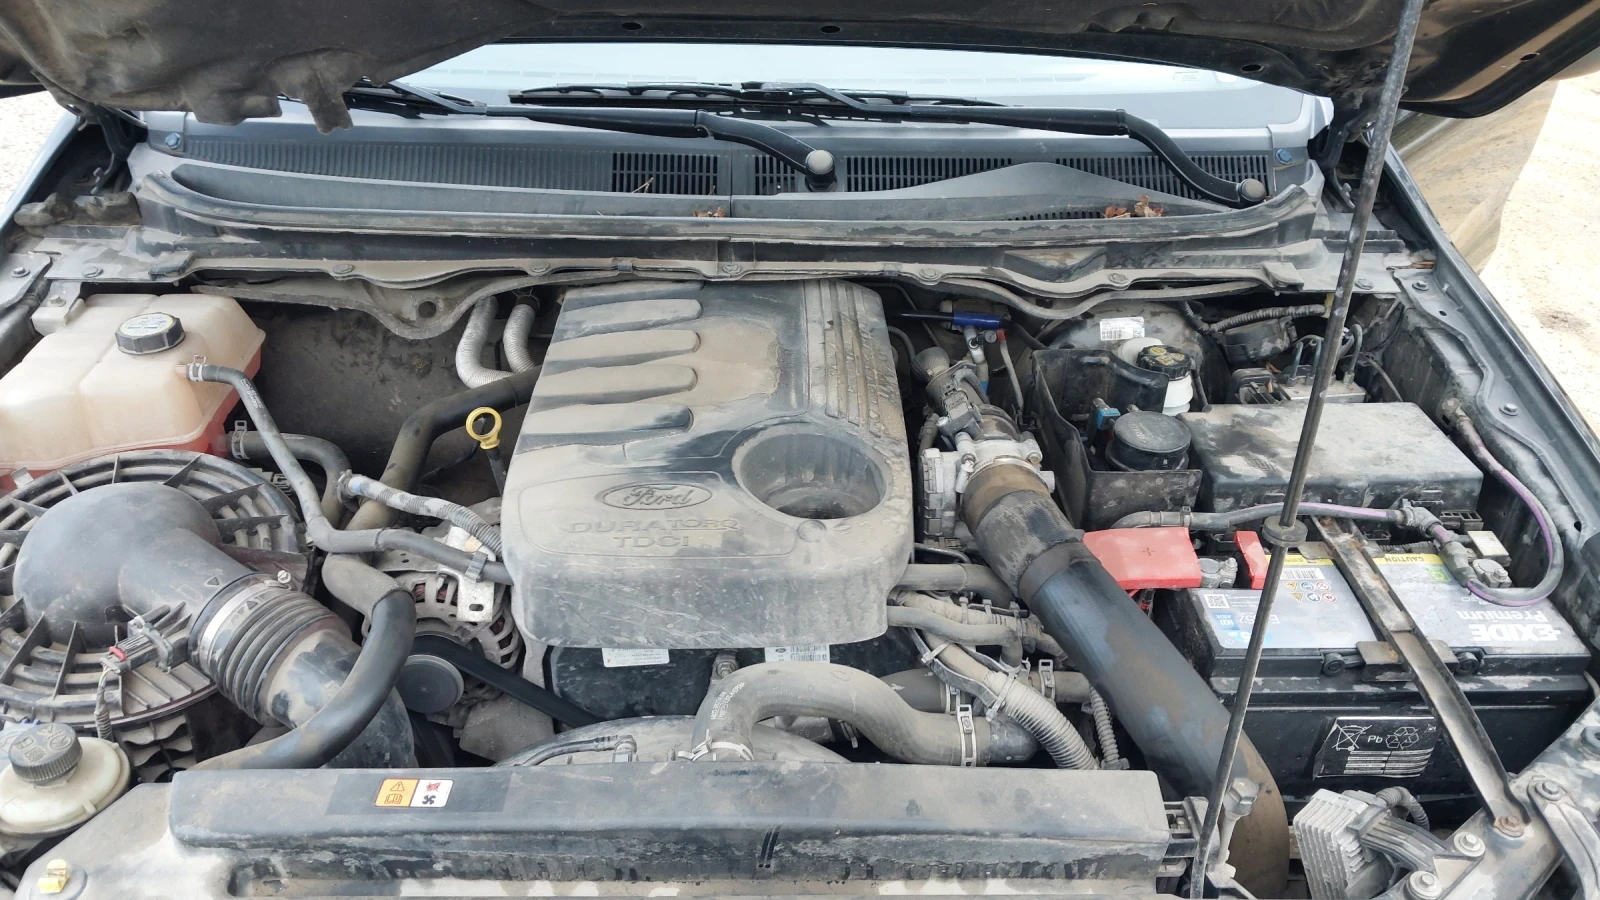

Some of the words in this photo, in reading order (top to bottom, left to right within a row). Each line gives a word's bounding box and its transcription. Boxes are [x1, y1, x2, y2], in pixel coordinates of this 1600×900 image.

[622, 485, 695, 506] Ford
[568, 518, 739, 534] DURATORQ
[1457, 610, 1549, 623] Premium
[1468, 623, 1561, 642] EXIDE
[1367, 735, 1383, 744] Pb
